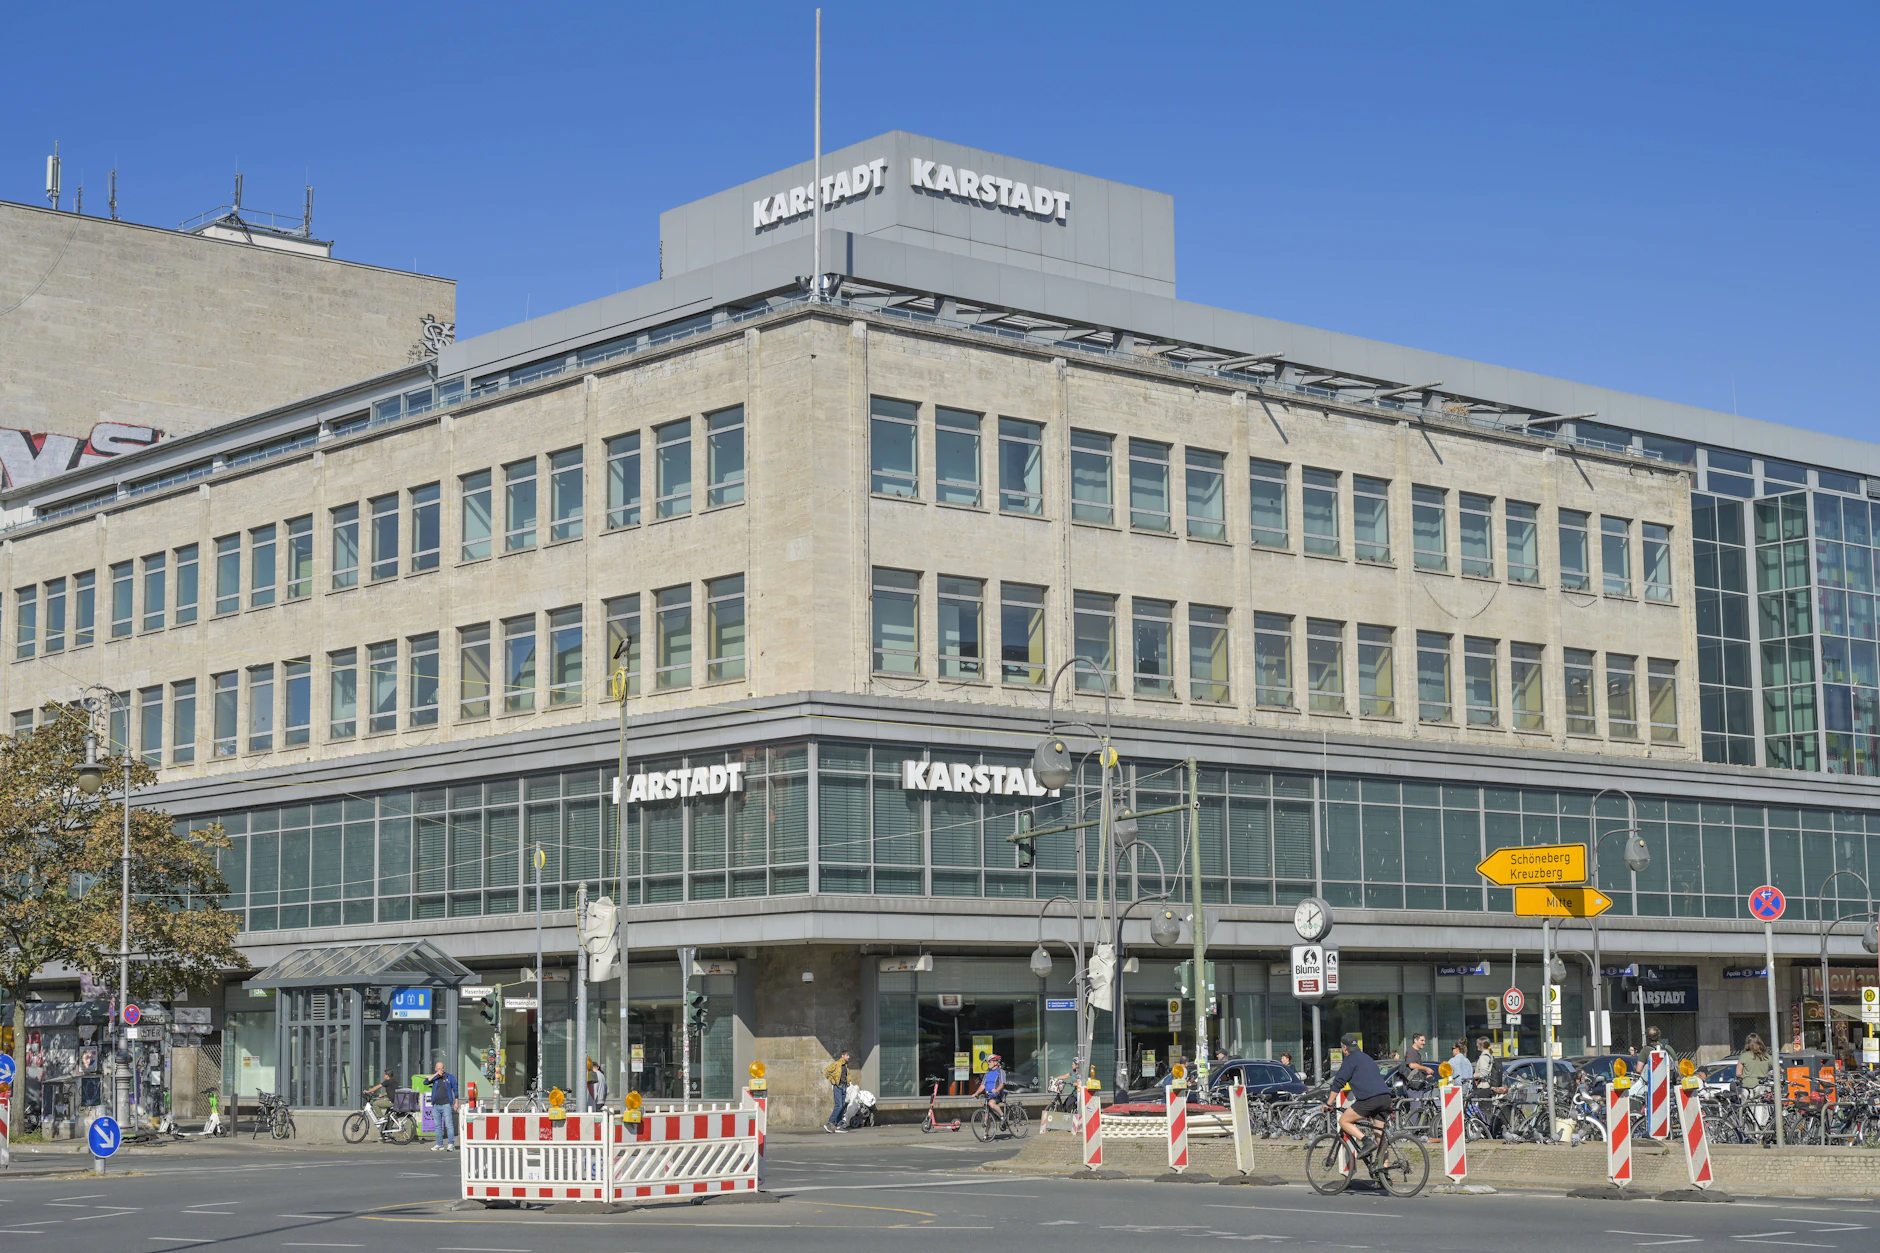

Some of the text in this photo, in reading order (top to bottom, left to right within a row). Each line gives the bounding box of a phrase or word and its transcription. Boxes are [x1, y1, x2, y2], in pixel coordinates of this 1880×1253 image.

[911, 157, 1070, 220] KARSTADT
[1511, 852, 1571, 865] Schöneberg
[1511, 868, 1563, 880] Kreuzberg
[1546, 896, 1573, 908] Mitte
[1295, 964, 1320, 975] Blume
[395, 993, 404, 1005] U
[1507, 995, 1520, 1007] 30
